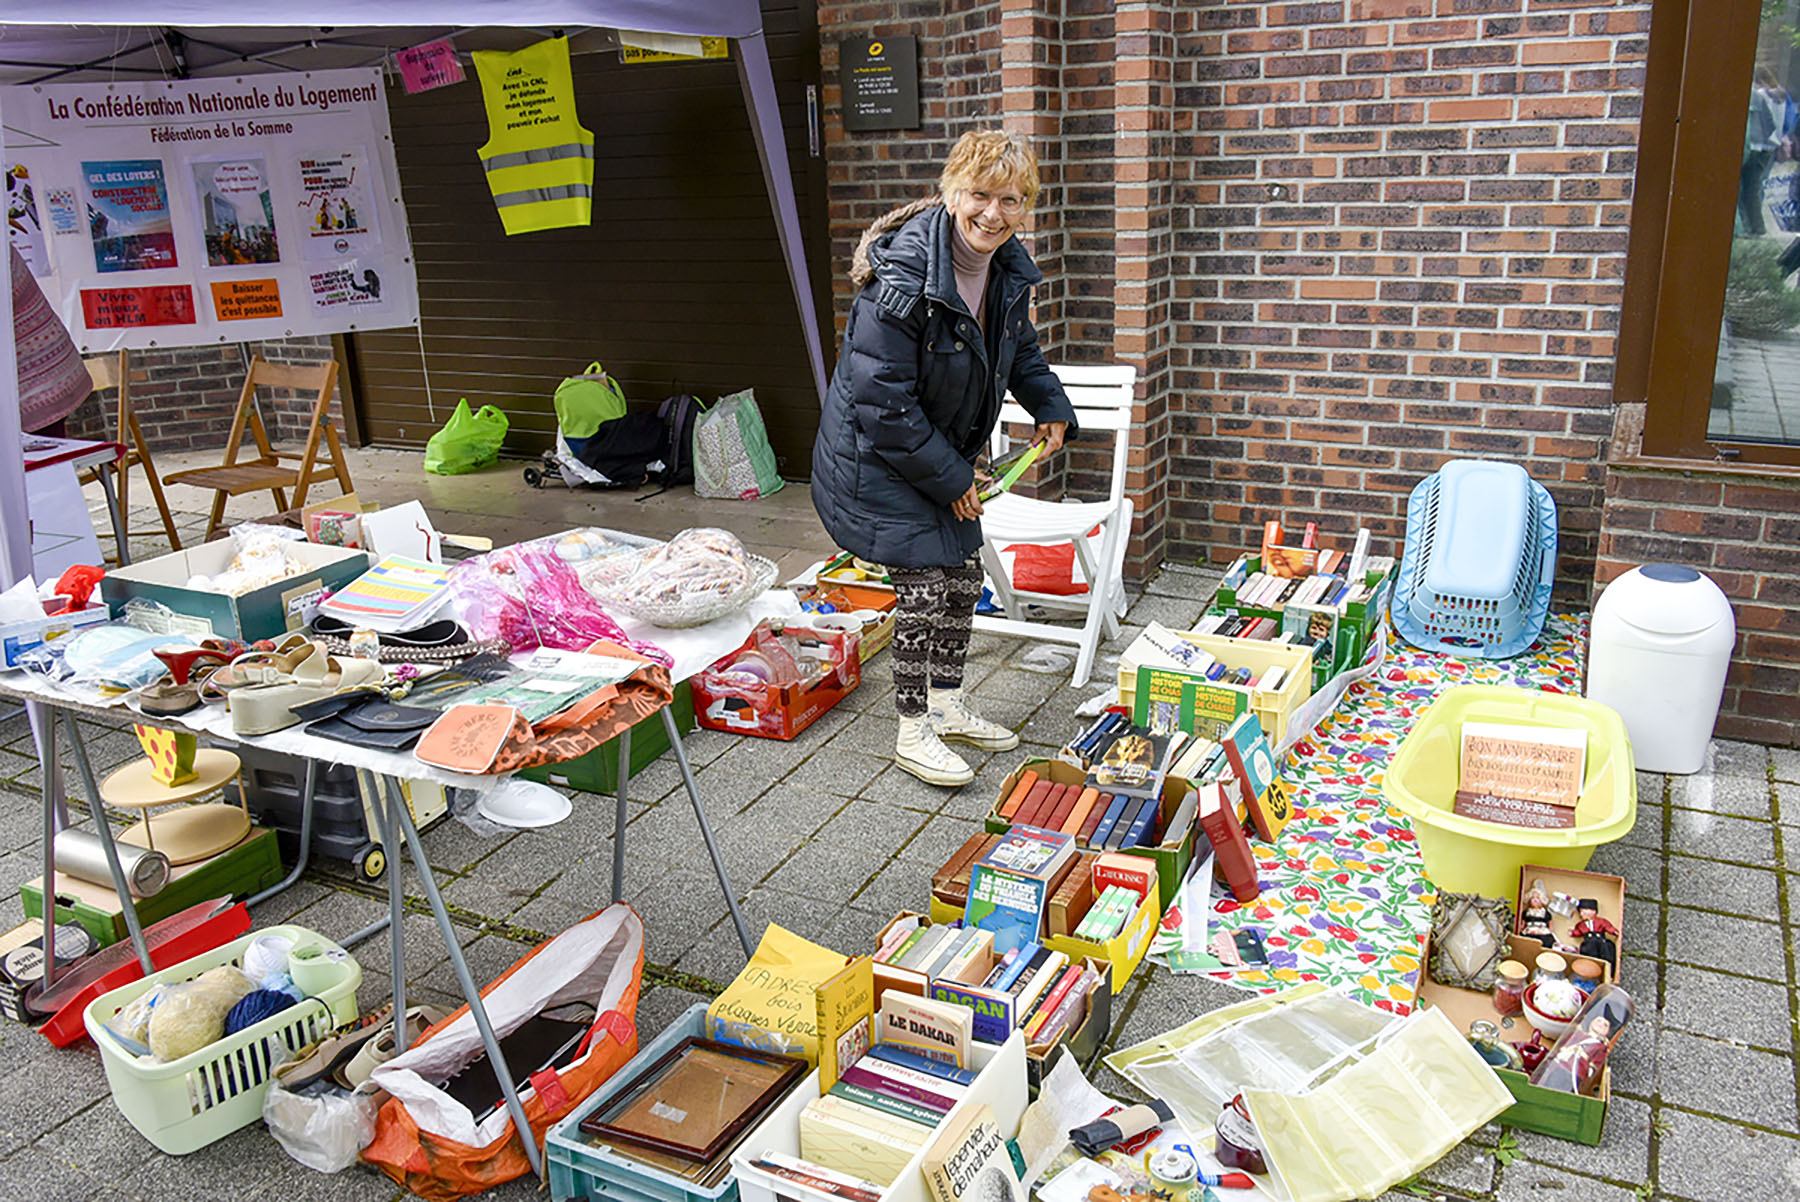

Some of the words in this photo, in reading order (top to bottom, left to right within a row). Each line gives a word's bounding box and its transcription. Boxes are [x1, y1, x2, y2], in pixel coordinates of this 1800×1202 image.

[48, 98, 70, 119] La
[74, 95, 185, 119] Confédération
[187, 87, 269, 114] Nationale
[274, 85, 295, 107] du
[299, 82, 378, 110] Logement
[151, 125, 211, 143] Fédération
[214, 123, 229, 138] de
[232, 121, 245, 137] la
[248, 120, 293, 136] Somme
[107, 171, 123, 182] DES
[124, 169, 156, 181] LOYERS
[232, 283, 263, 294] Baisser
[98, 292, 136, 303] Vivre
[220, 295, 234, 305] les
[236, 294, 279, 306] quittances
[97, 305, 139, 314] mieux
[222, 306, 242, 317] c'est
[244, 304, 278, 317] possible
[116, 313, 146, 325] HLM
[744, 966, 820, 995] CADRES
[766, 992, 802, 1012] bois
[936, 989, 1006, 1019] SAGAN
[715, 999, 769, 1028] plaques
[889, 1013, 907, 1030] LE
[909, 1019, 956, 1047] DAKAR
